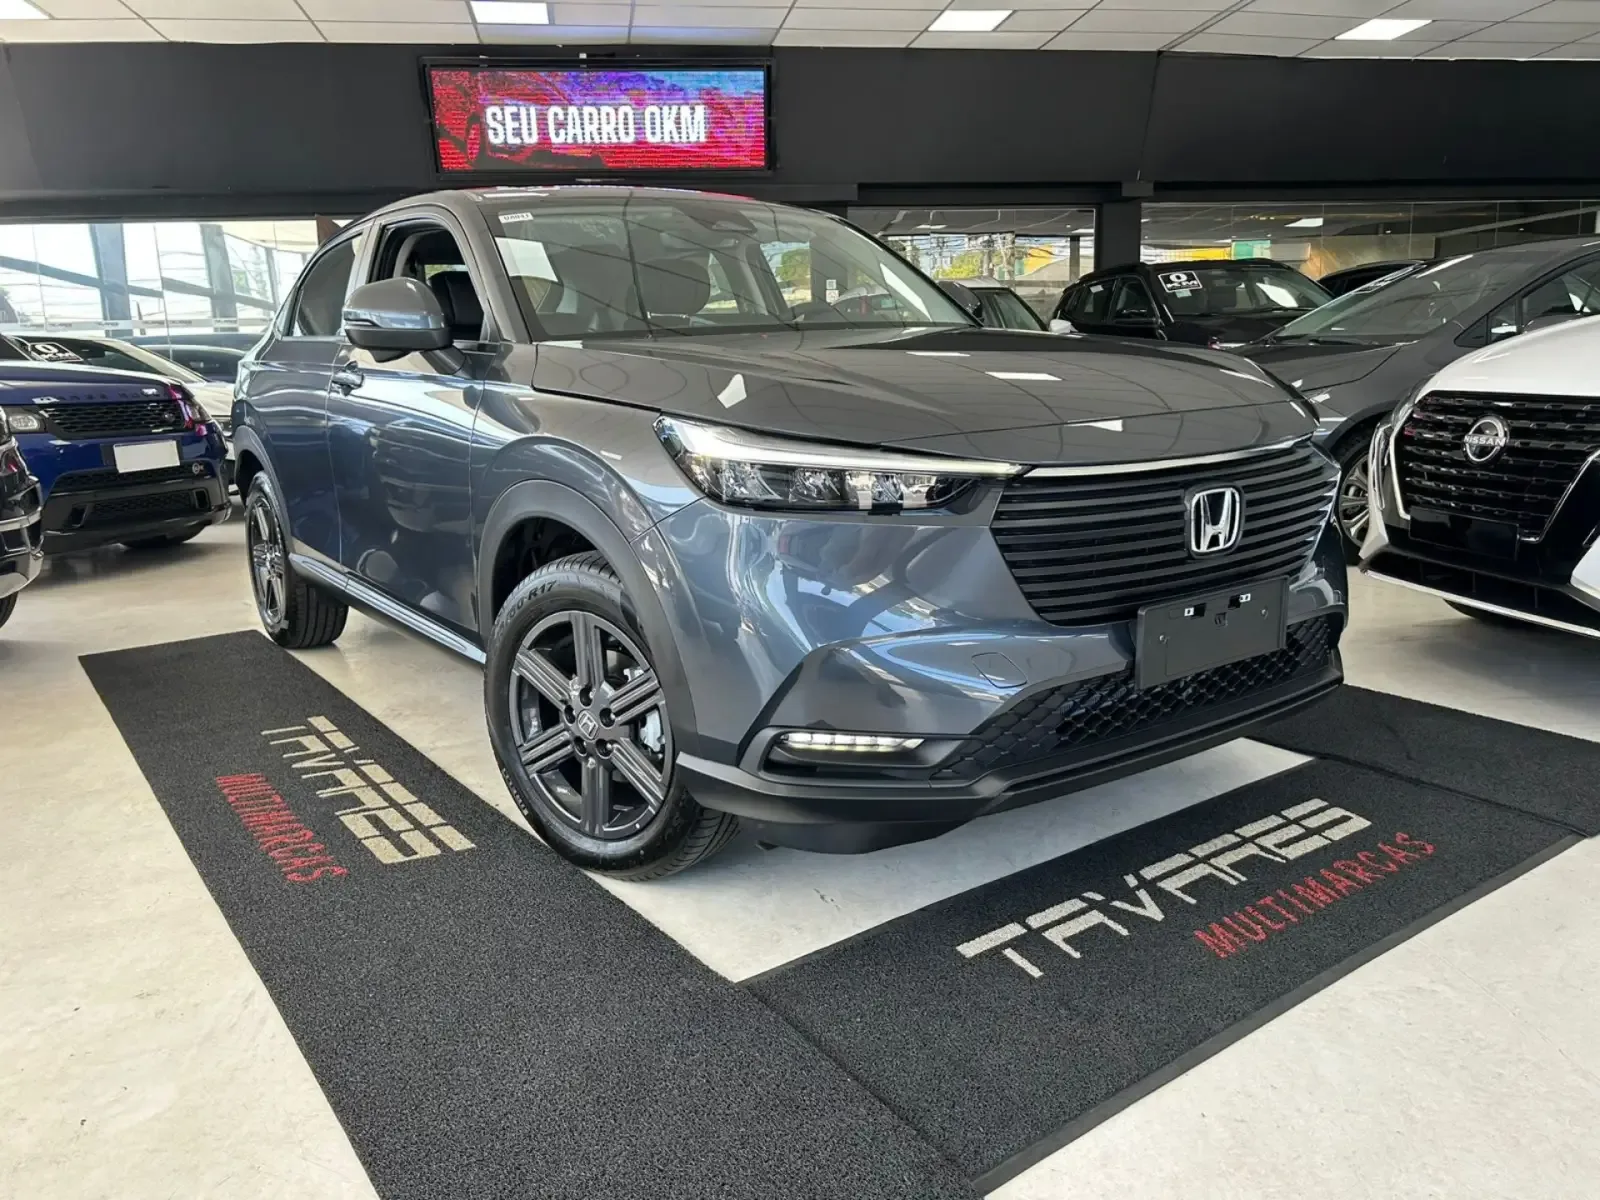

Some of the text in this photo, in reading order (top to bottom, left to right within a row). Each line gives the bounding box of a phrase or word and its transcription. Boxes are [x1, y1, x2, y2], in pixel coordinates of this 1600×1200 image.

[486, 106, 538, 144] SEU
[549, 106, 635, 143] CARRO
[1464, 435, 1506, 447] NISSAN
[527, 581, 557, 600] R17
[261, 715, 476, 864] TAVARES
[956, 798, 1372, 978] TAVARES
[1194, 832, 1436, 959] MULTIMARCAS
